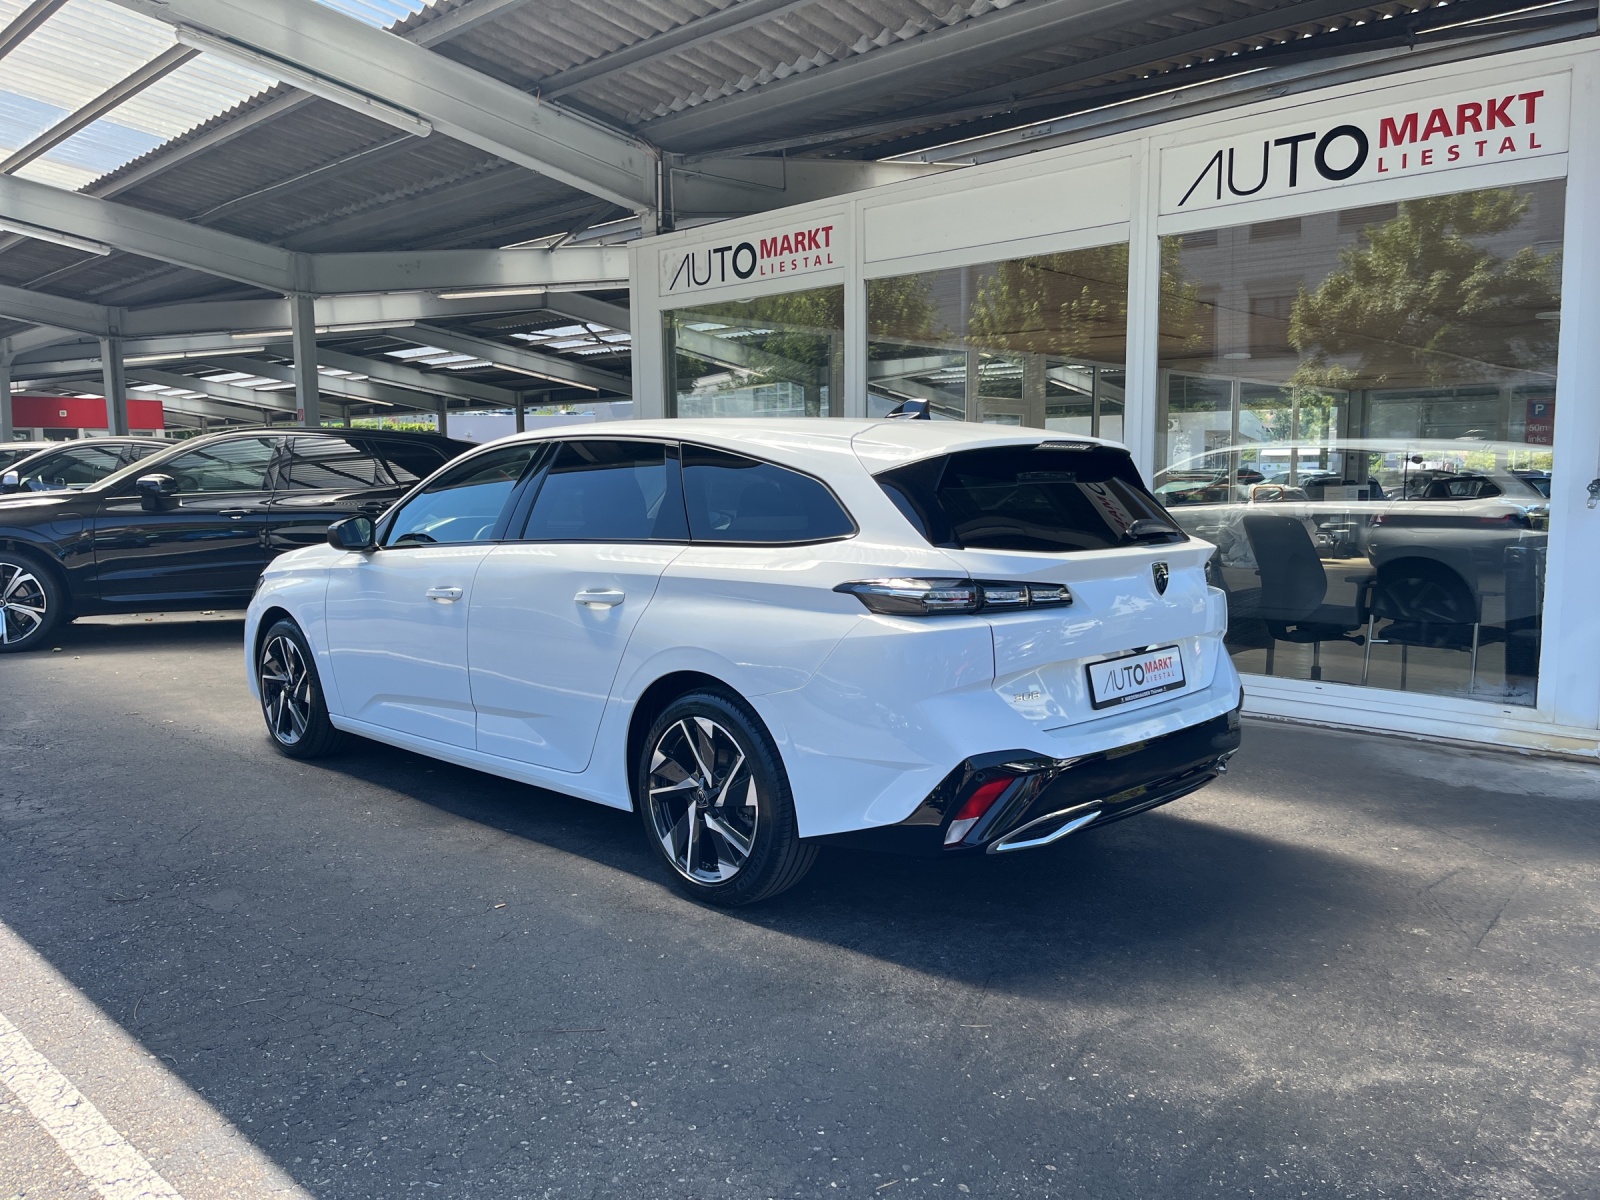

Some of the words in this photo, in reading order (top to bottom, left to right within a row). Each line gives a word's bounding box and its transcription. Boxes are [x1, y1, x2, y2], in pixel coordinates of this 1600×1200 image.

[1178, 124, 1369, 206] AUTO
[1379, 90, 1544, 148] MARKT
[1377, 132, 1542, 173] LIESTAL
[669, 242, 757, 291] AUTO
[759, 225, 833, 260] MARKT
[760, 253, 833, 276] LIESTAL
[1534, 404, 1545, 415] P
[1527, 434, 1547, 443] links
[1528, 423, 1548, 432] 50m
[1104, 663, 1145, 694] AUTO
[1144, 656, 1173, 675] MARKT
[1146, 670, 1175, 683] LIESTAL
